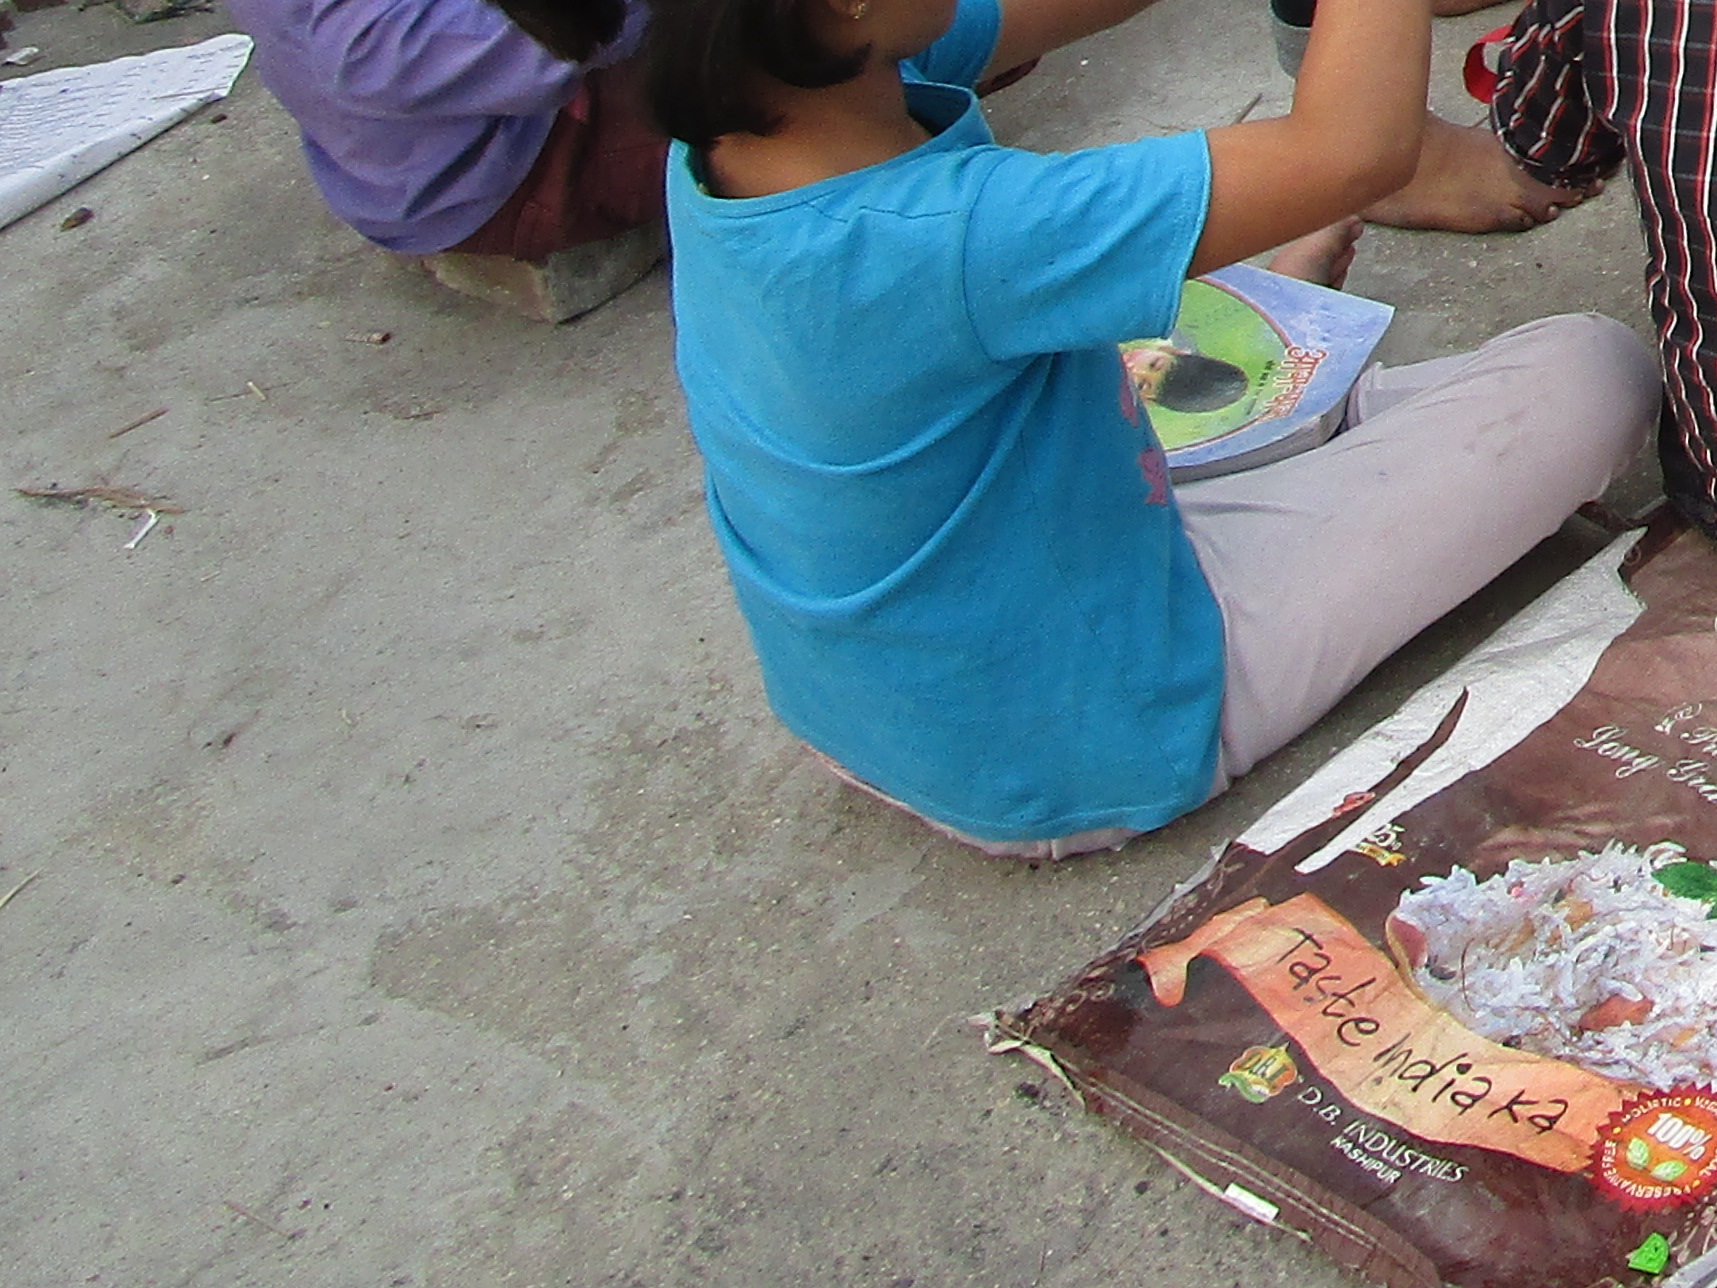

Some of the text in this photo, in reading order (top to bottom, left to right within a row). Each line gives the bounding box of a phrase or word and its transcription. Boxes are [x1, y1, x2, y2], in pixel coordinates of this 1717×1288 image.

[1573, 725, 1664, 779] Long
[1276, 927, 1380, 1047] Taste
[1373, 1033, 1492, 1116] India
[1298, 1085, 1470, 1183] D.B. INDUSTRIES
[1329, 1135, 1402, 1184] KASHIPUR
[1646, 1112, 1712, 1161] 100%
